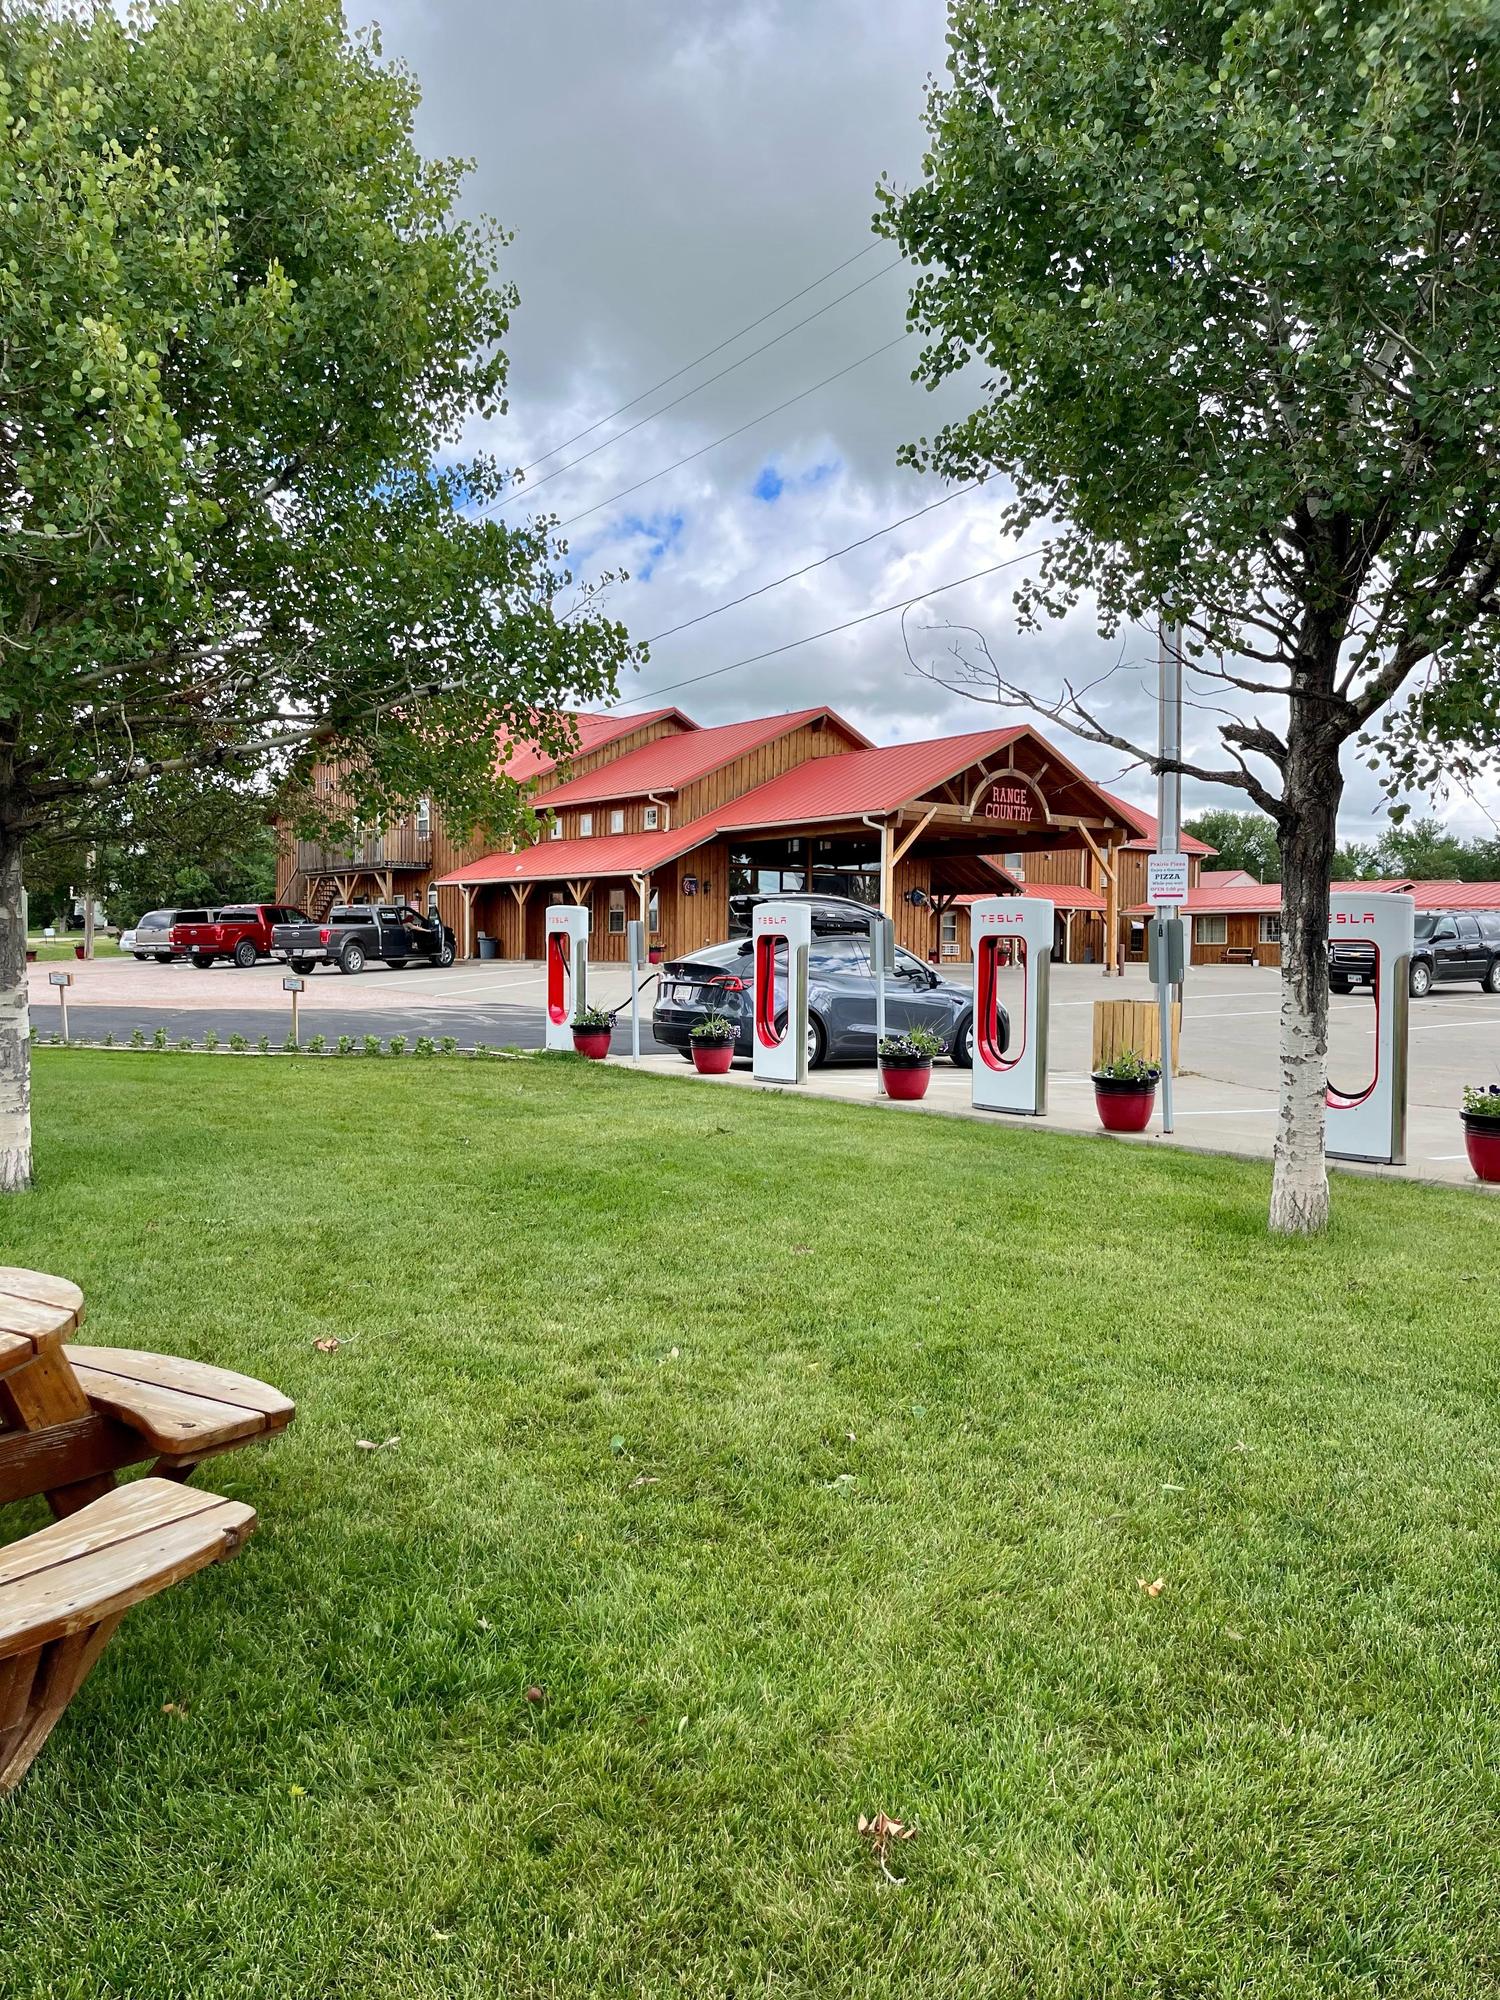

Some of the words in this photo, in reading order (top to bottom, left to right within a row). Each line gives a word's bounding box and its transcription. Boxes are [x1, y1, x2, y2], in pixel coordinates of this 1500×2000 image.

[992, 786, 1026, 804] RANGE
[985, 803, 1032, 822] COUNTRY
[981, 914, 1023, 922] TESLA
[1328, 914, 1374, 923] SLA
